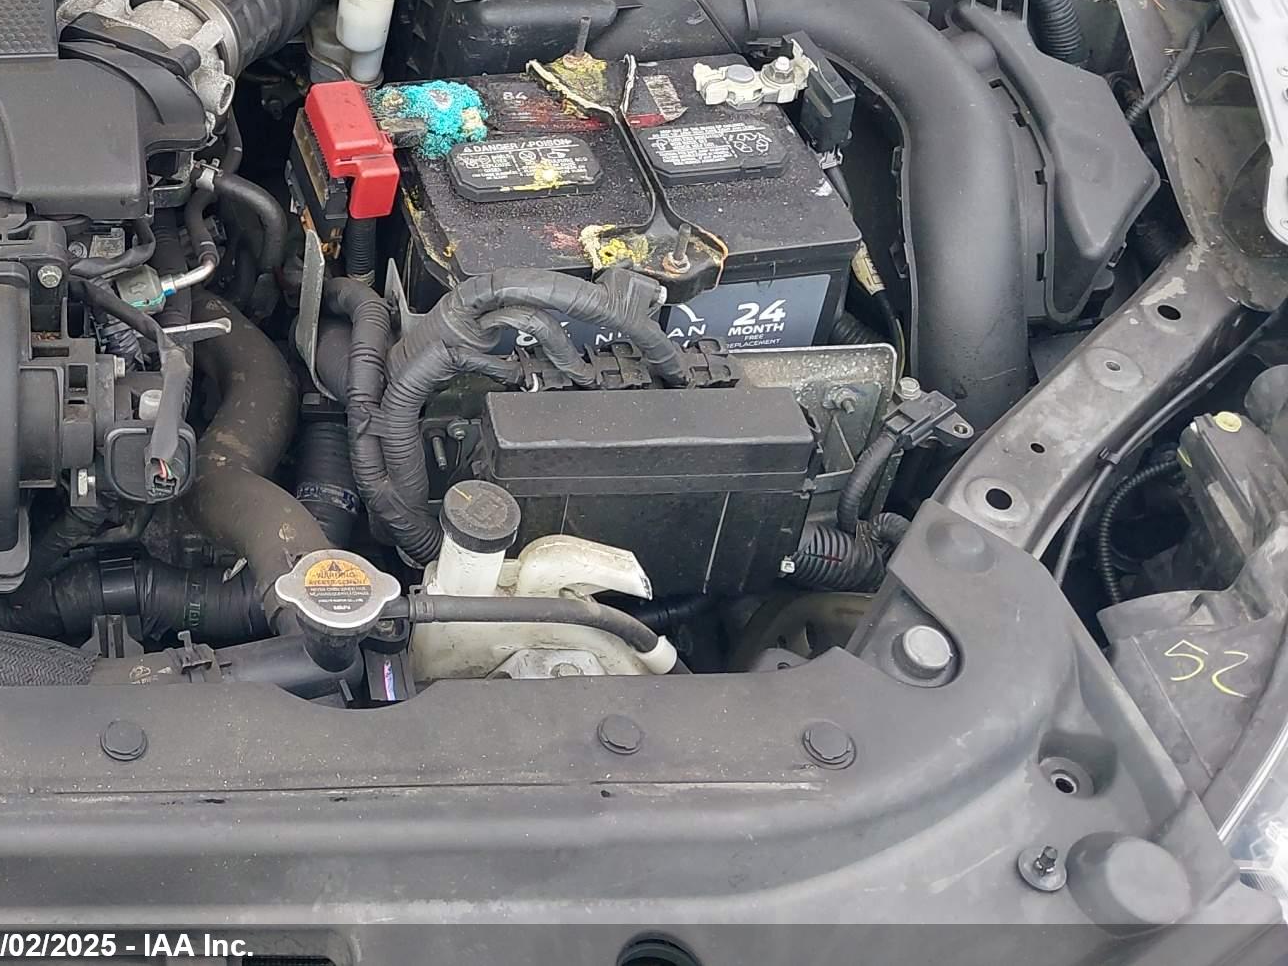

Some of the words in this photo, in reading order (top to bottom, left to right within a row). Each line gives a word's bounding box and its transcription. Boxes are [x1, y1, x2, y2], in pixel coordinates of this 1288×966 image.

[473, 142, 518, 152] DANGER
[527, 138, 572, 148] POISON
[733, 299, 787, 326] 24
[727, 322, 785, 336] MONTH
[1163, 638, 1250, 699] 52
